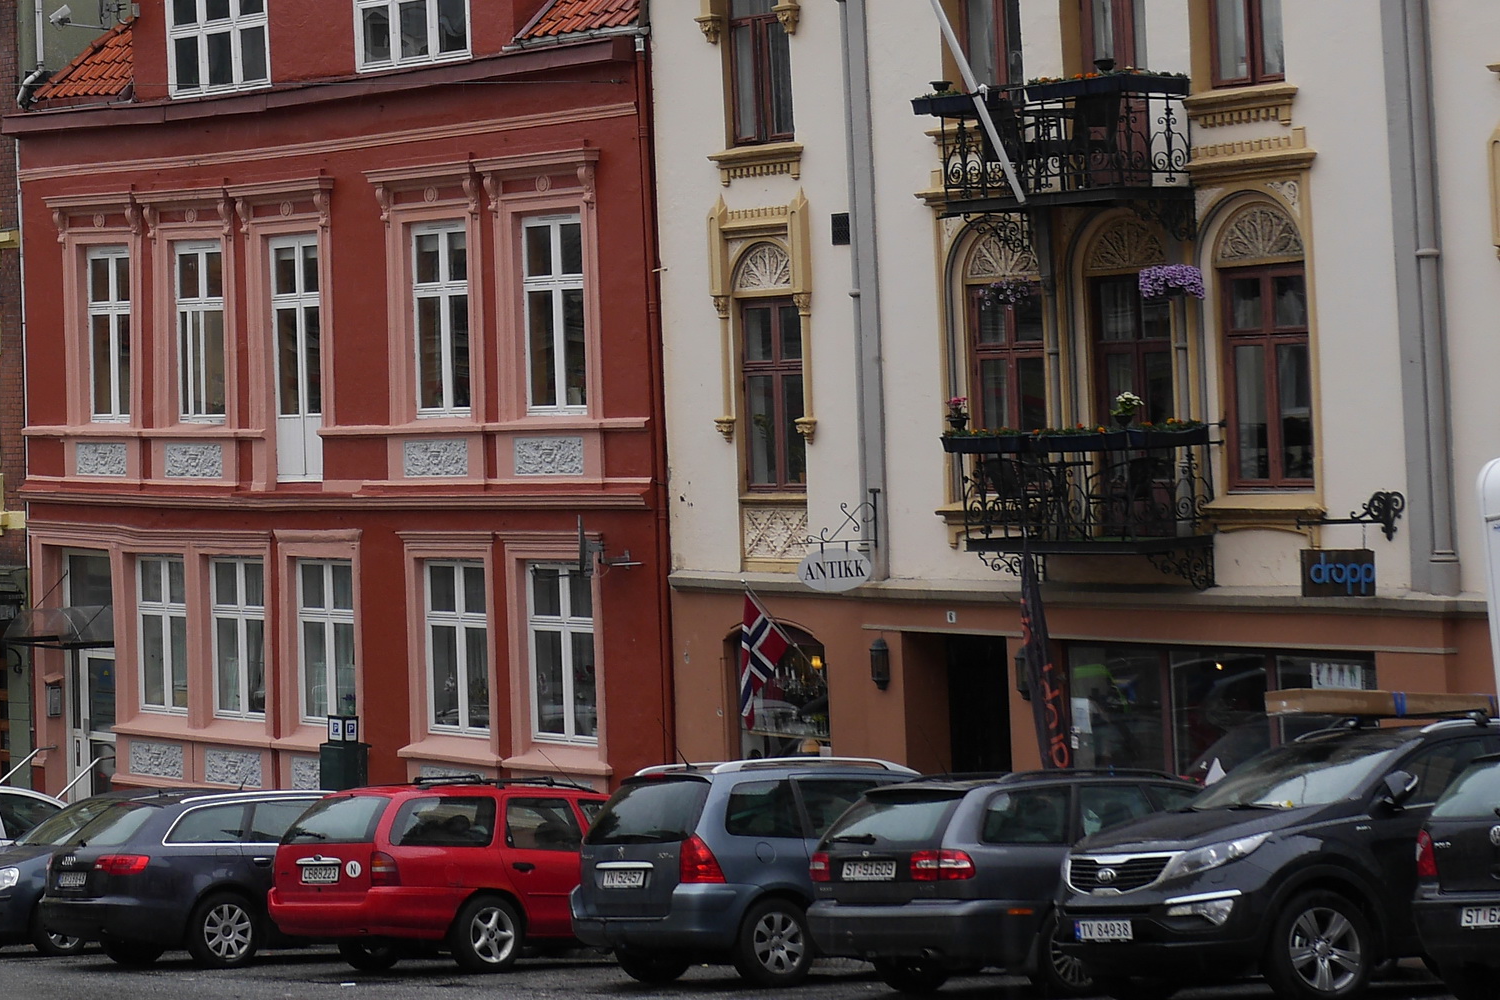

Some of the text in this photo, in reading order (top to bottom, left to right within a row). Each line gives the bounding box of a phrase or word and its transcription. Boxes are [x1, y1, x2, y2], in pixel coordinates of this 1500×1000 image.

[805, 560, 866, 581] ANTIKK
[1310, 552, 1375, 595] dropp
[350, 863, 357, 876] N
[845, 862, 857, 876] ST
[1465, 909, 1482, 924] ST
[1081, 922, 1129, 937] TV 84938
